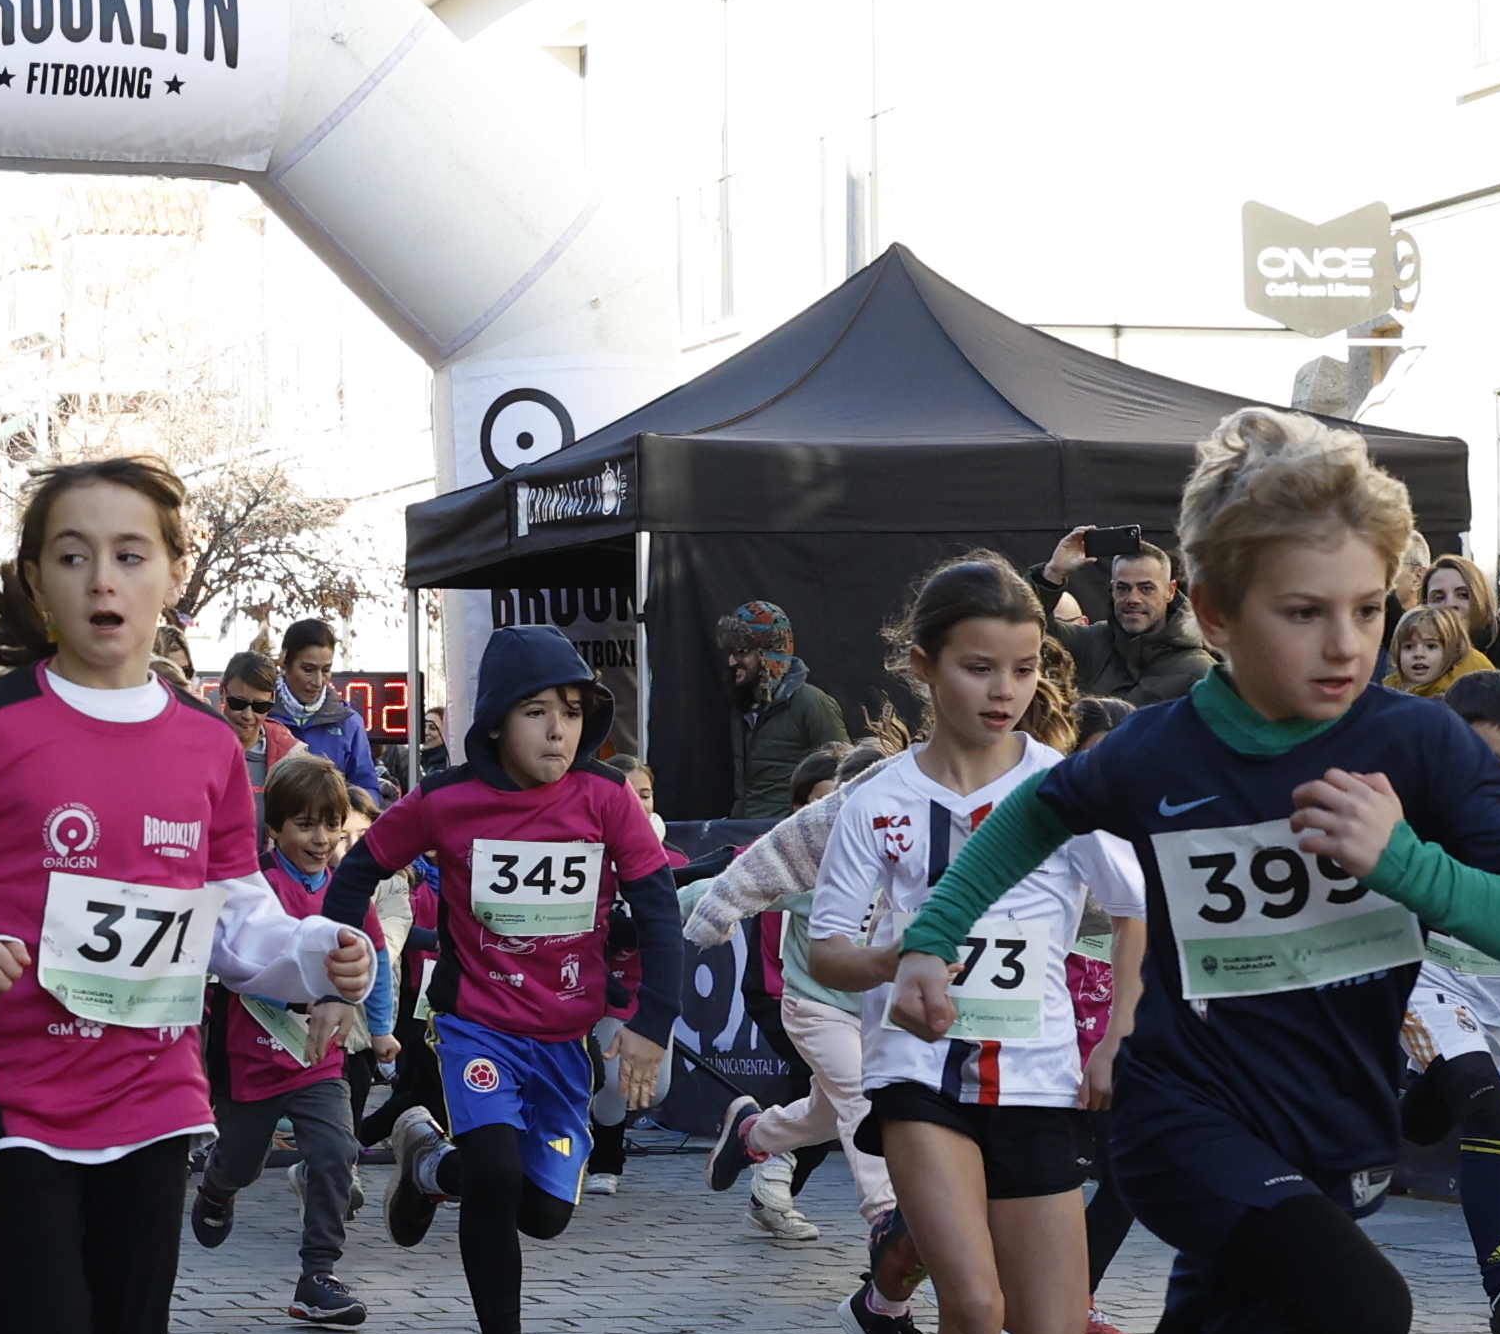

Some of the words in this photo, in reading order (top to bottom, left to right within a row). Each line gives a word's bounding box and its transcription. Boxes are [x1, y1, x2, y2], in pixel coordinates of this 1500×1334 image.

[26, 62, 153, 99] FITBOXING
[1257, 246, 1377, 278] ONCE
[143, 814, 202, 851] BROOKLYN
[43, 856, 98, 869] ORIGEN
[489, 854, 587, 896] 345
[77, 900, 194, 968] 371
[951, 937, 1027, 990] 73
[48, 1023, 74, 1036] GM
